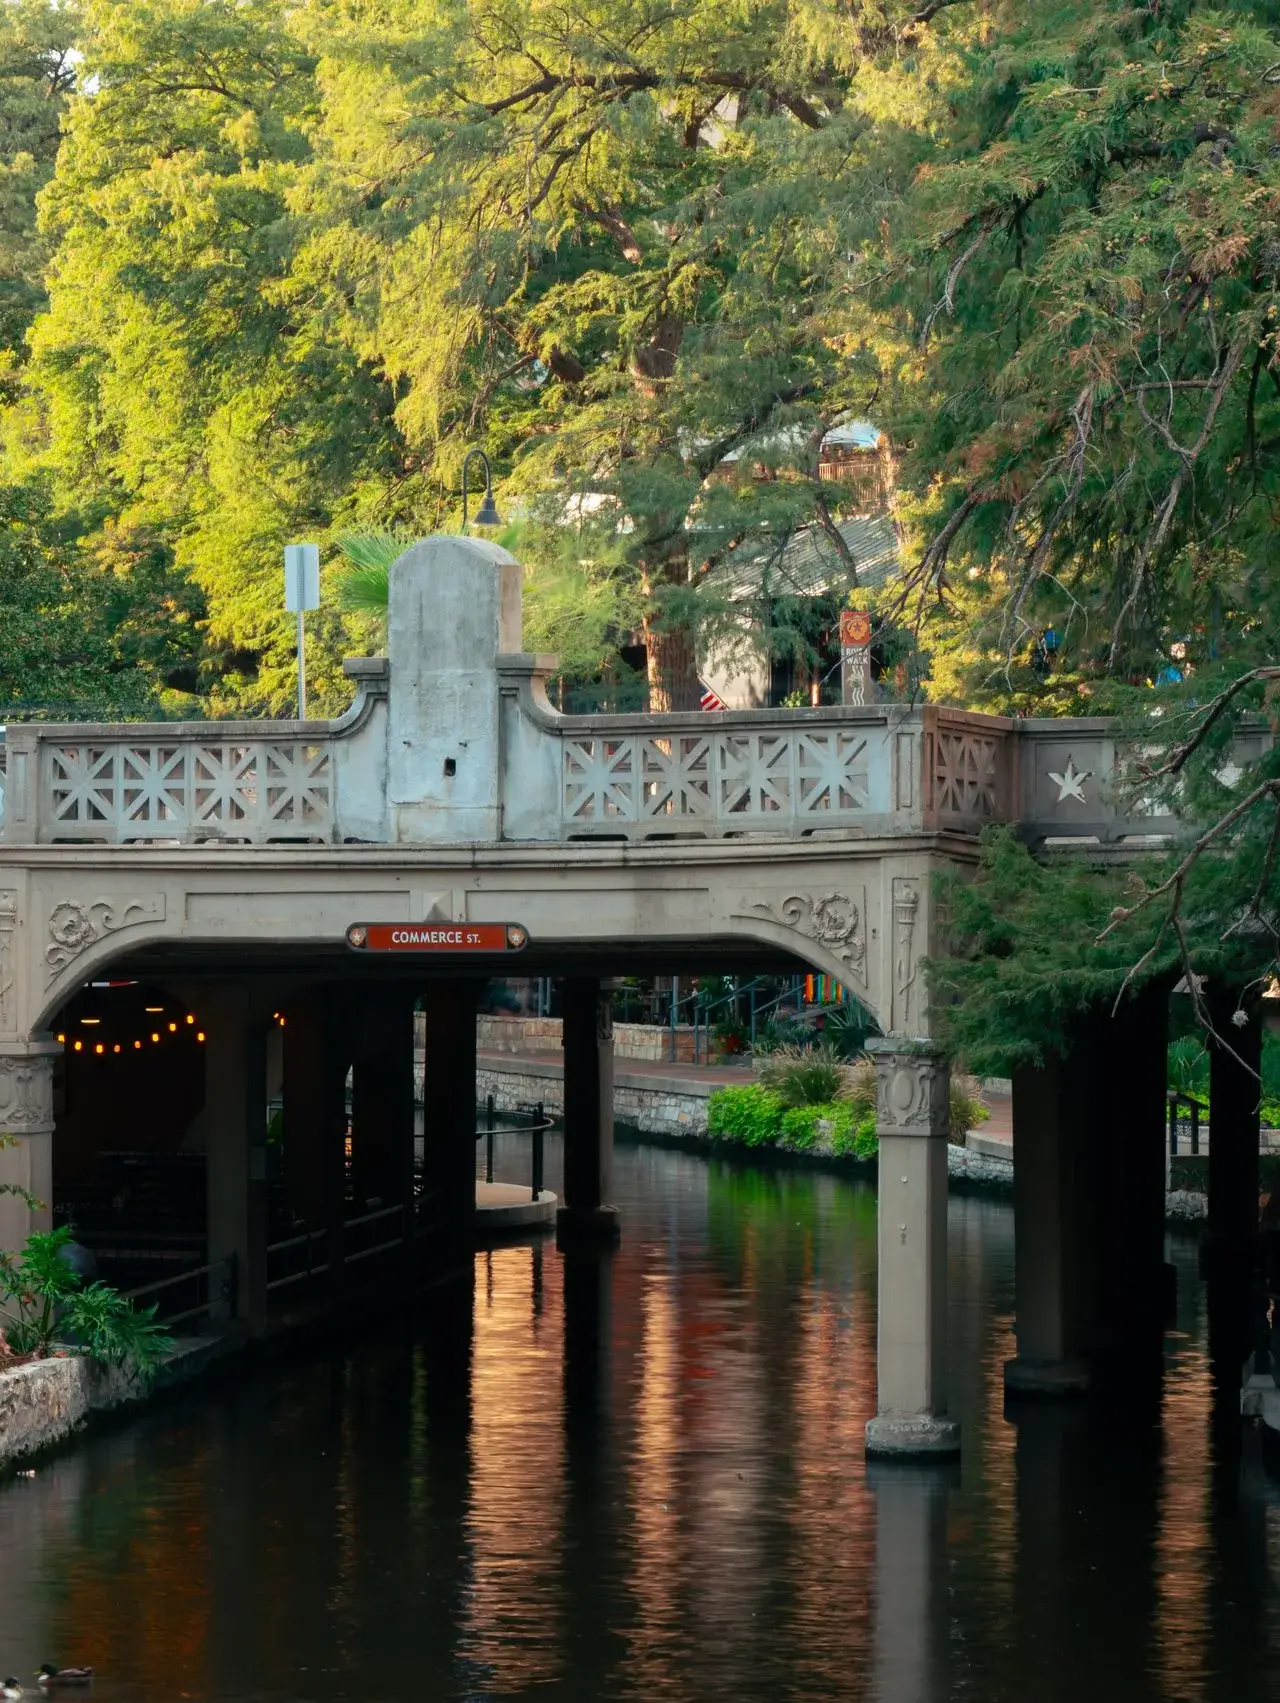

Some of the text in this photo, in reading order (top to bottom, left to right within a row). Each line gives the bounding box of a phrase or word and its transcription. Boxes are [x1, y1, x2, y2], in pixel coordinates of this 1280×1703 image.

[846, 656, 869, 665] WALK
[391, 931, 481, 944] COMMERCE ST.
